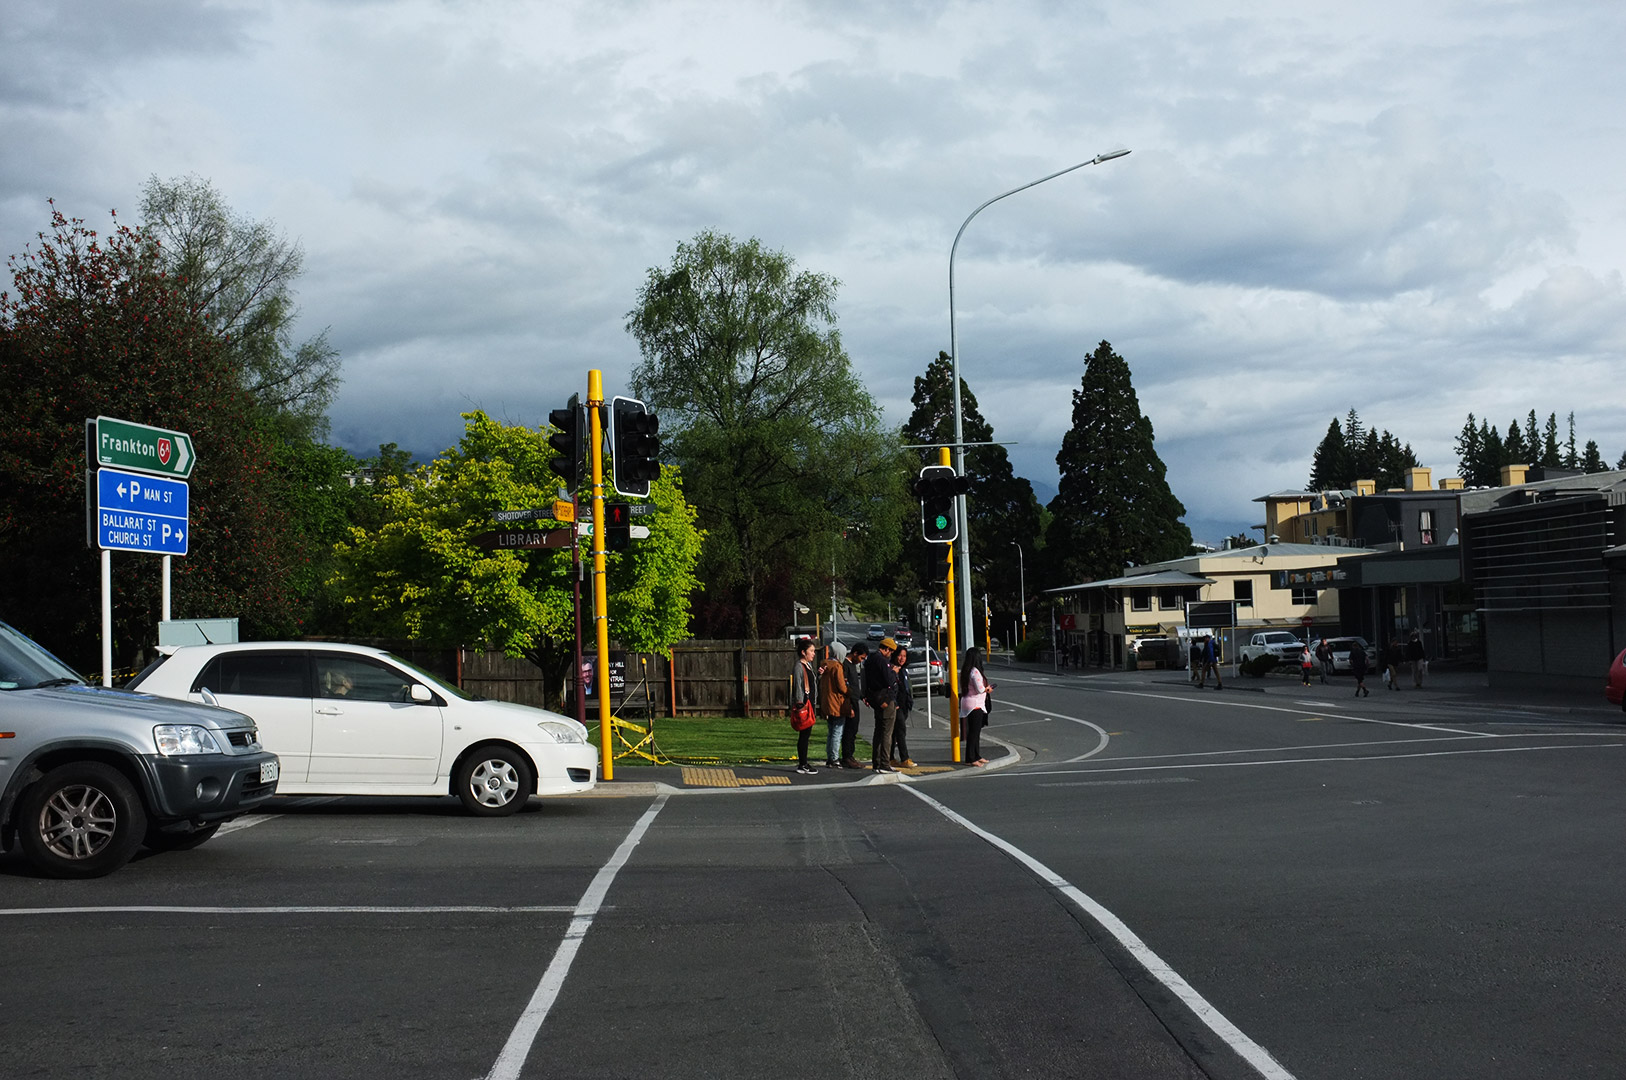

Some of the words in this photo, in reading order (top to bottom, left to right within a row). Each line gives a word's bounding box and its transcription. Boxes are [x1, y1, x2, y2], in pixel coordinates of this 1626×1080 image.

[101, 433, 155, 457] Frankton
[130, 481, 141, 503] P
[144, 487, 161, 502] MAN
[163, 491, 173, 504] ST
[103, 513, 144, 531] BALLARAT
[147, 519, 157, 532] ST
[497, 510, 532, 521] SHOTOVER
[533, 509, 554, 519] STREE
[108, 530, 140, 546] CHURCH
[142, 534, 153, 547] ST
[162, 524, 172, 545] P
[498, 533, 549, 546] LIBRARY
